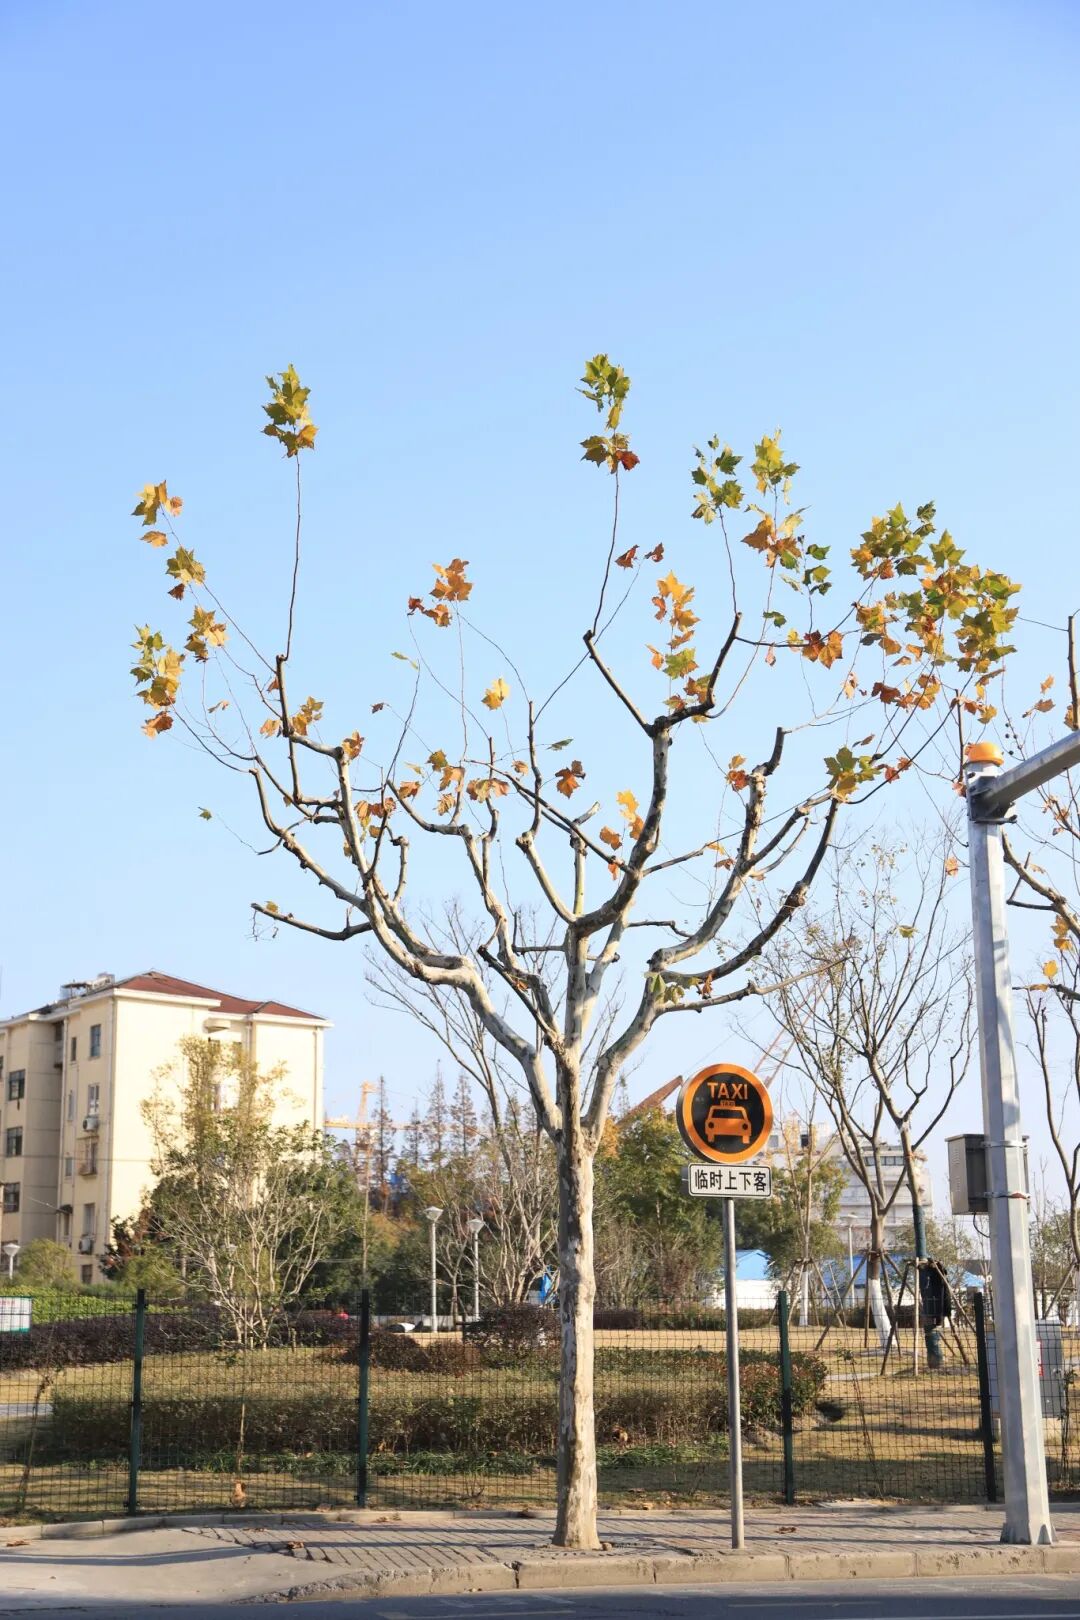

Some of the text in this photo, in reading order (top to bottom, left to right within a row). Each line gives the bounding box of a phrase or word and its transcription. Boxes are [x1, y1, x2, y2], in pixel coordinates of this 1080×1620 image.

[707, 1082, 748, 1099] TAXI
[695, 1169, 767, 1192] 临时上下客
